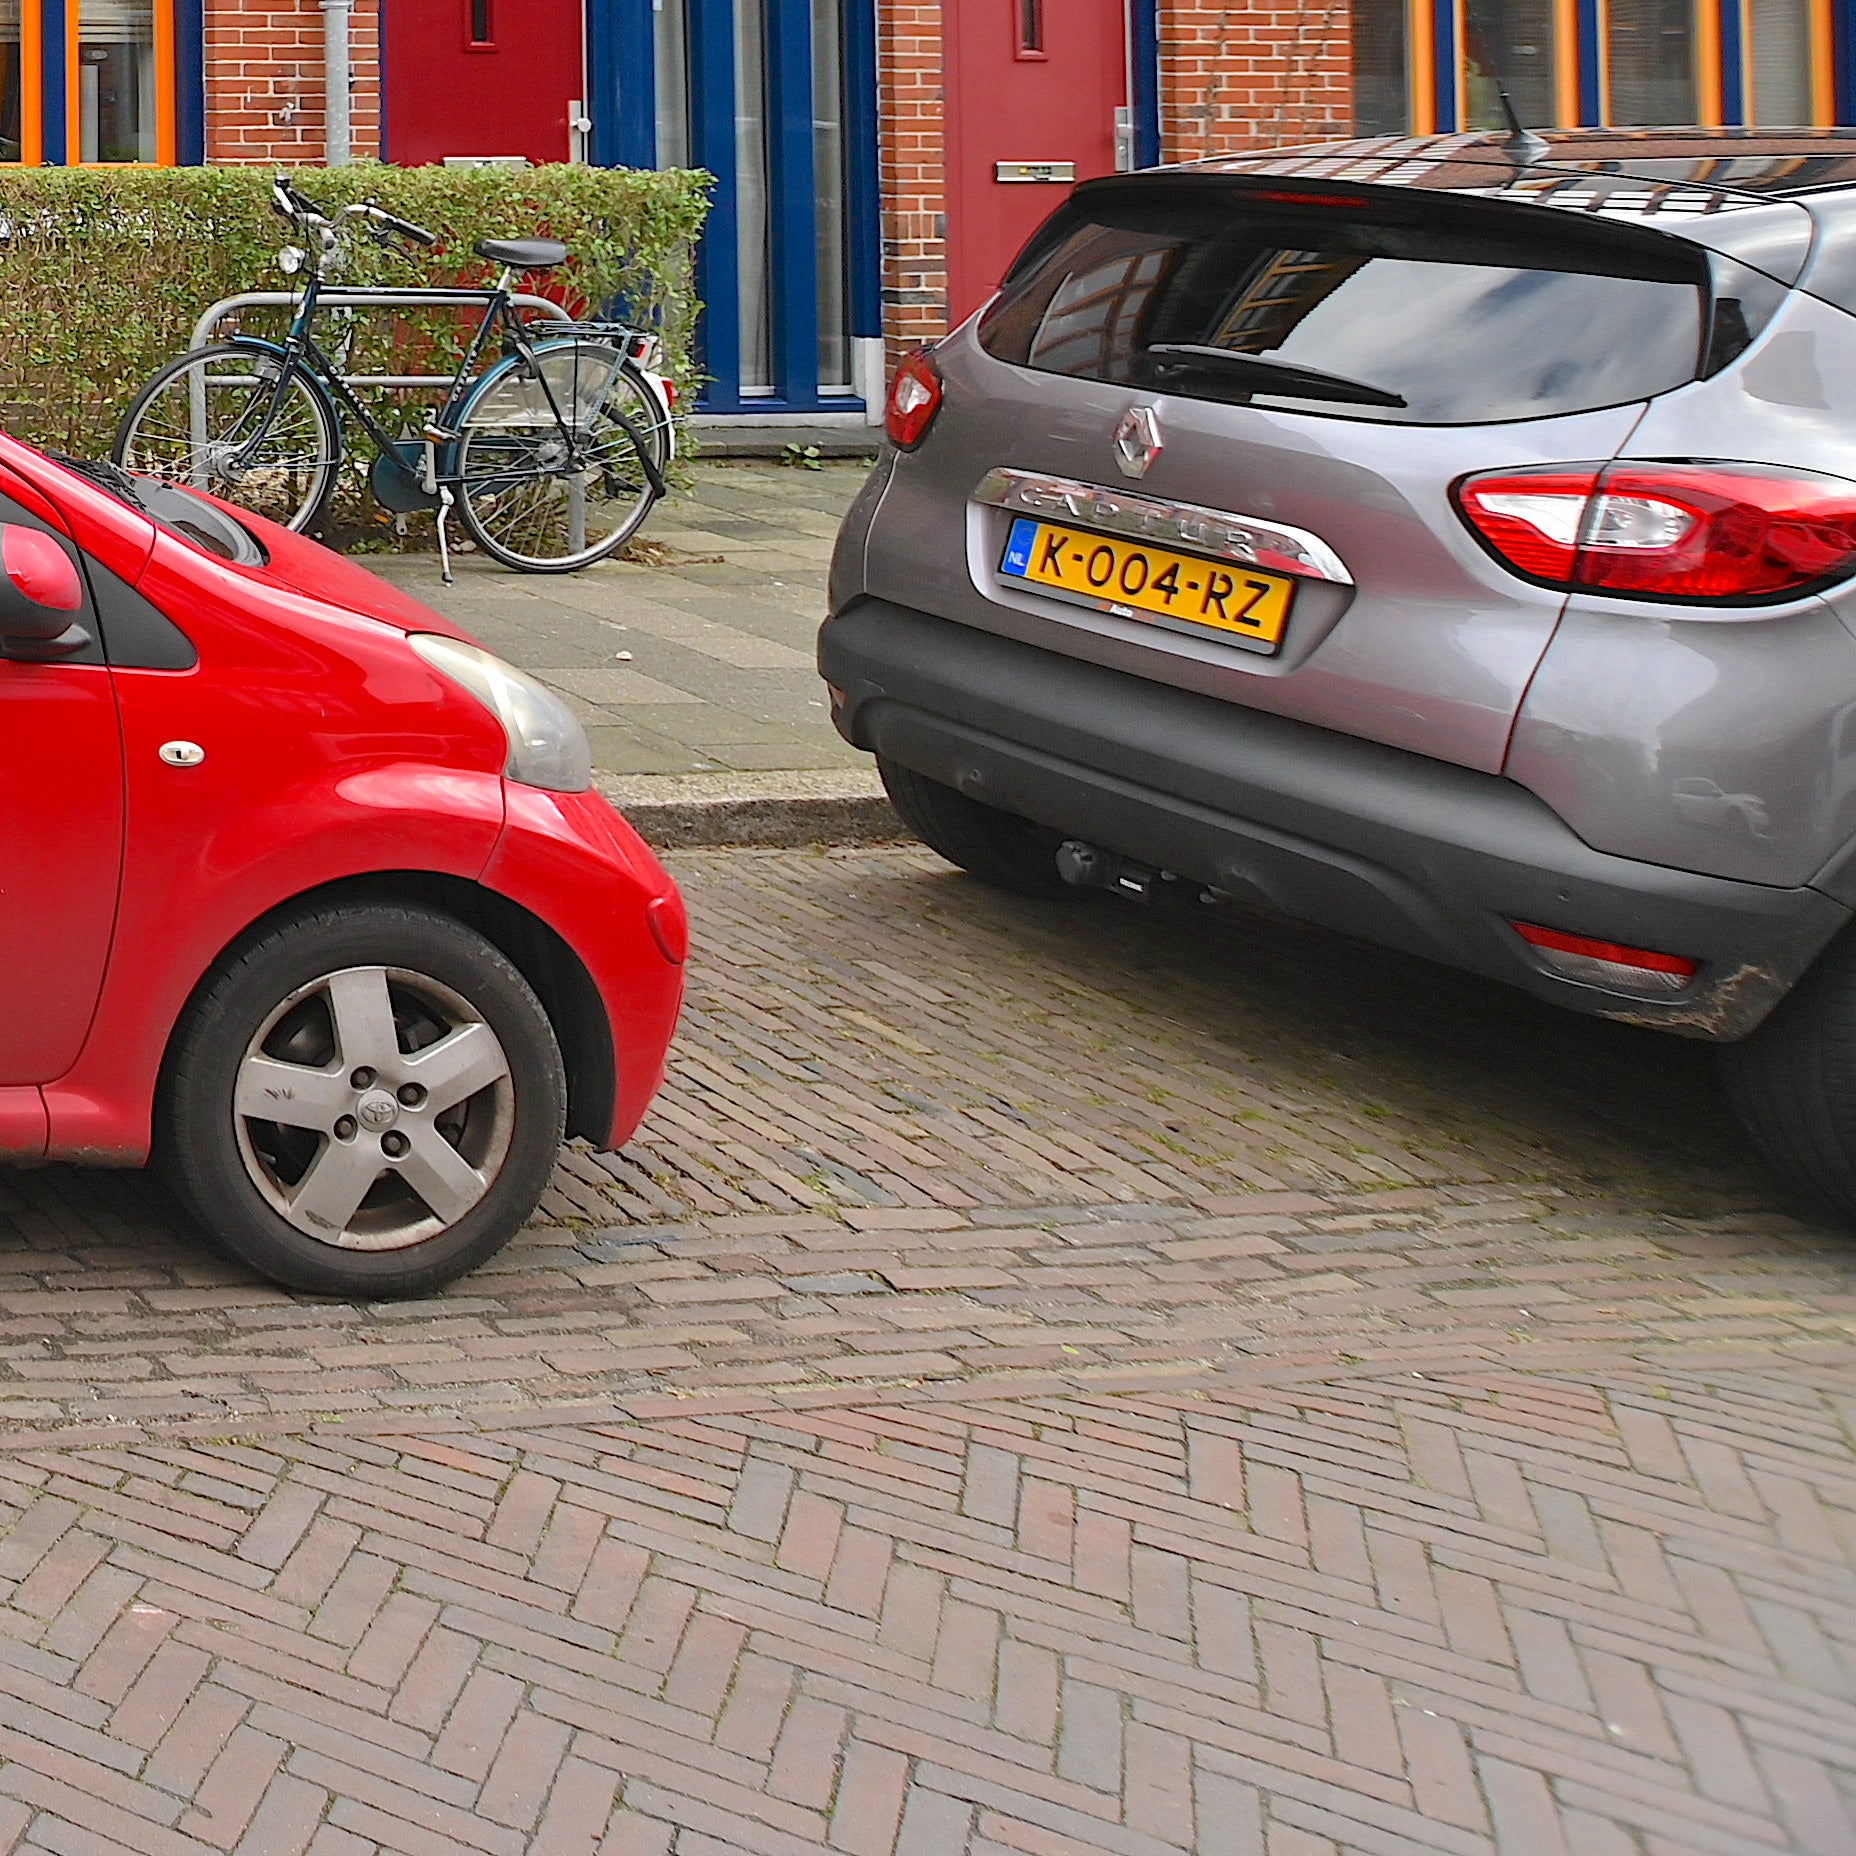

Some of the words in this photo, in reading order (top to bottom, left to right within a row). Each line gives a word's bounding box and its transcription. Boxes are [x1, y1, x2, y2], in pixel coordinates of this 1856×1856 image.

[1019, 487, 1258, 564] CAPTUR
[1008, 550, 1026, 568] NL
[1039, 532, 1272, 628] K-004-RZ
